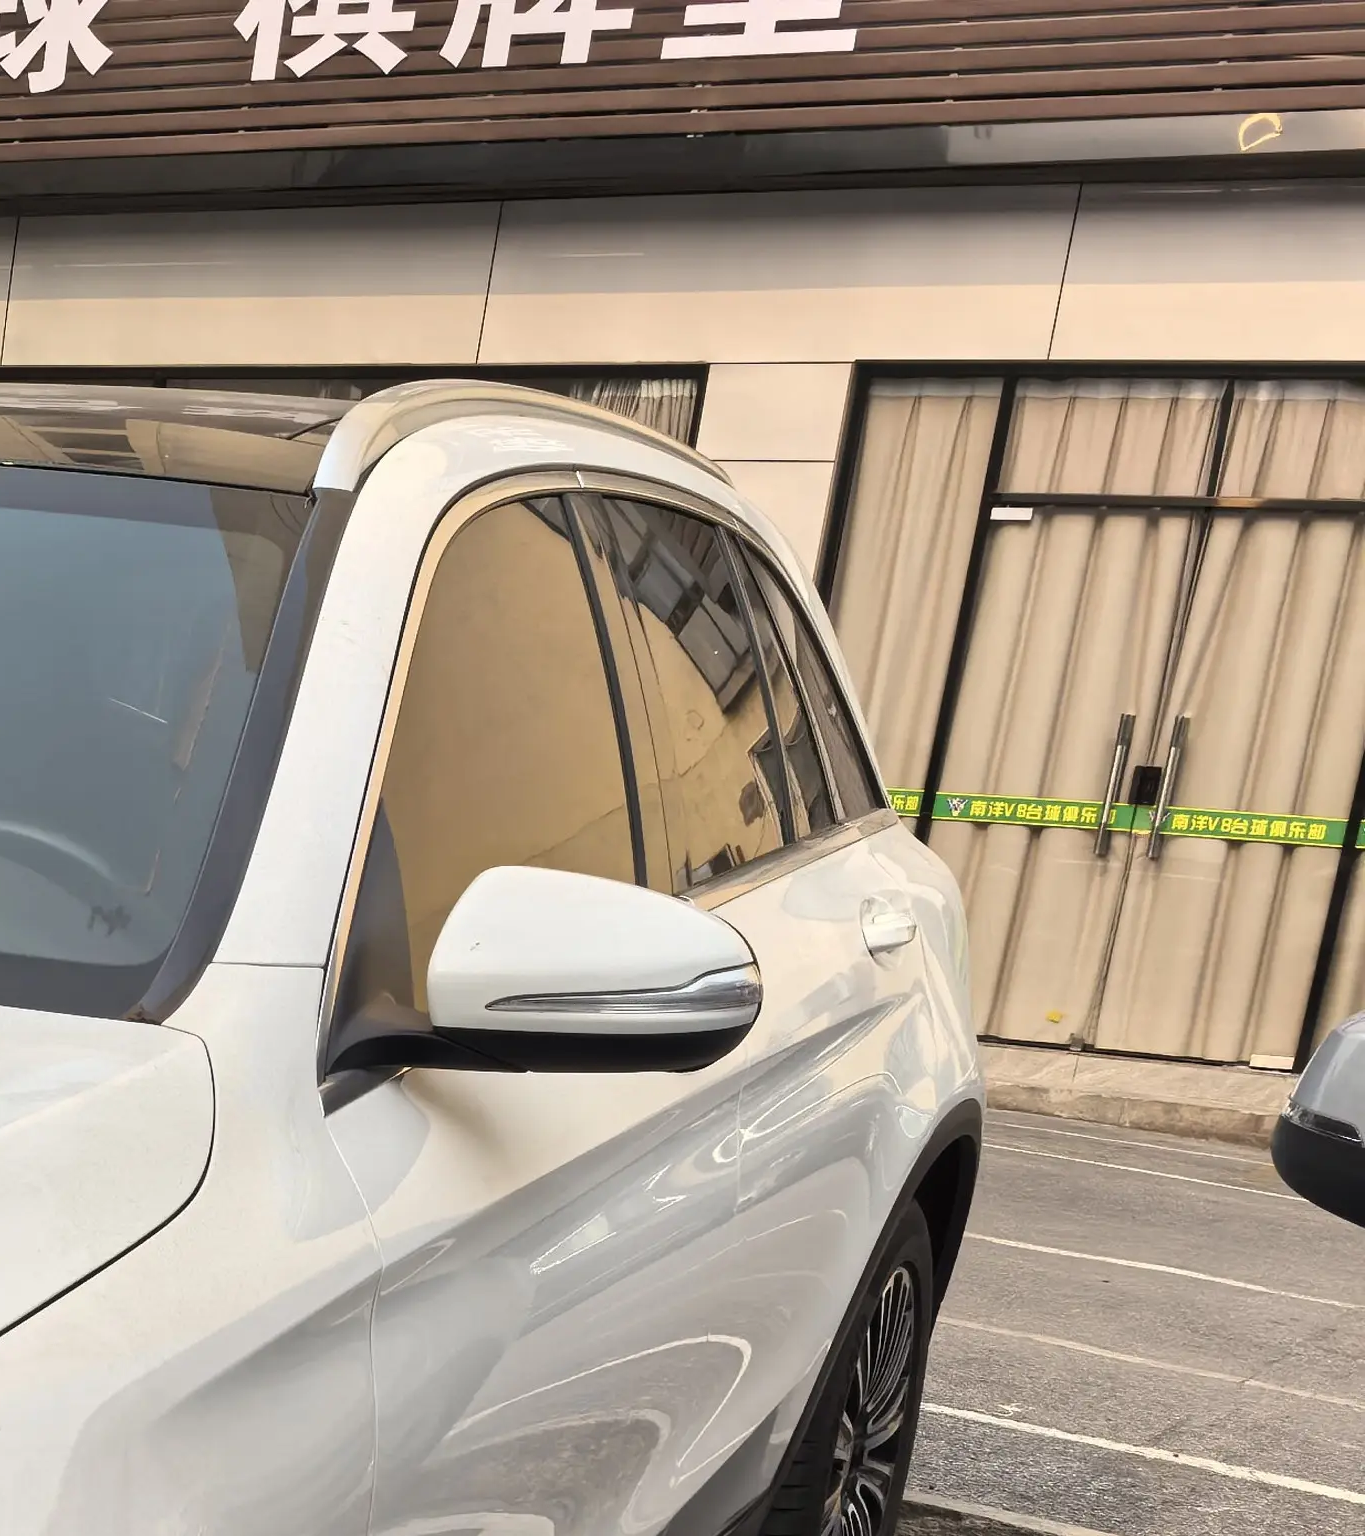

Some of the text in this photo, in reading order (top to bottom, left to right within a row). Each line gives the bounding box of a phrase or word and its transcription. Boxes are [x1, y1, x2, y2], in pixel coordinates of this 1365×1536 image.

[1171, 813, 1327, 841] 南洋V8台球俱乐部
